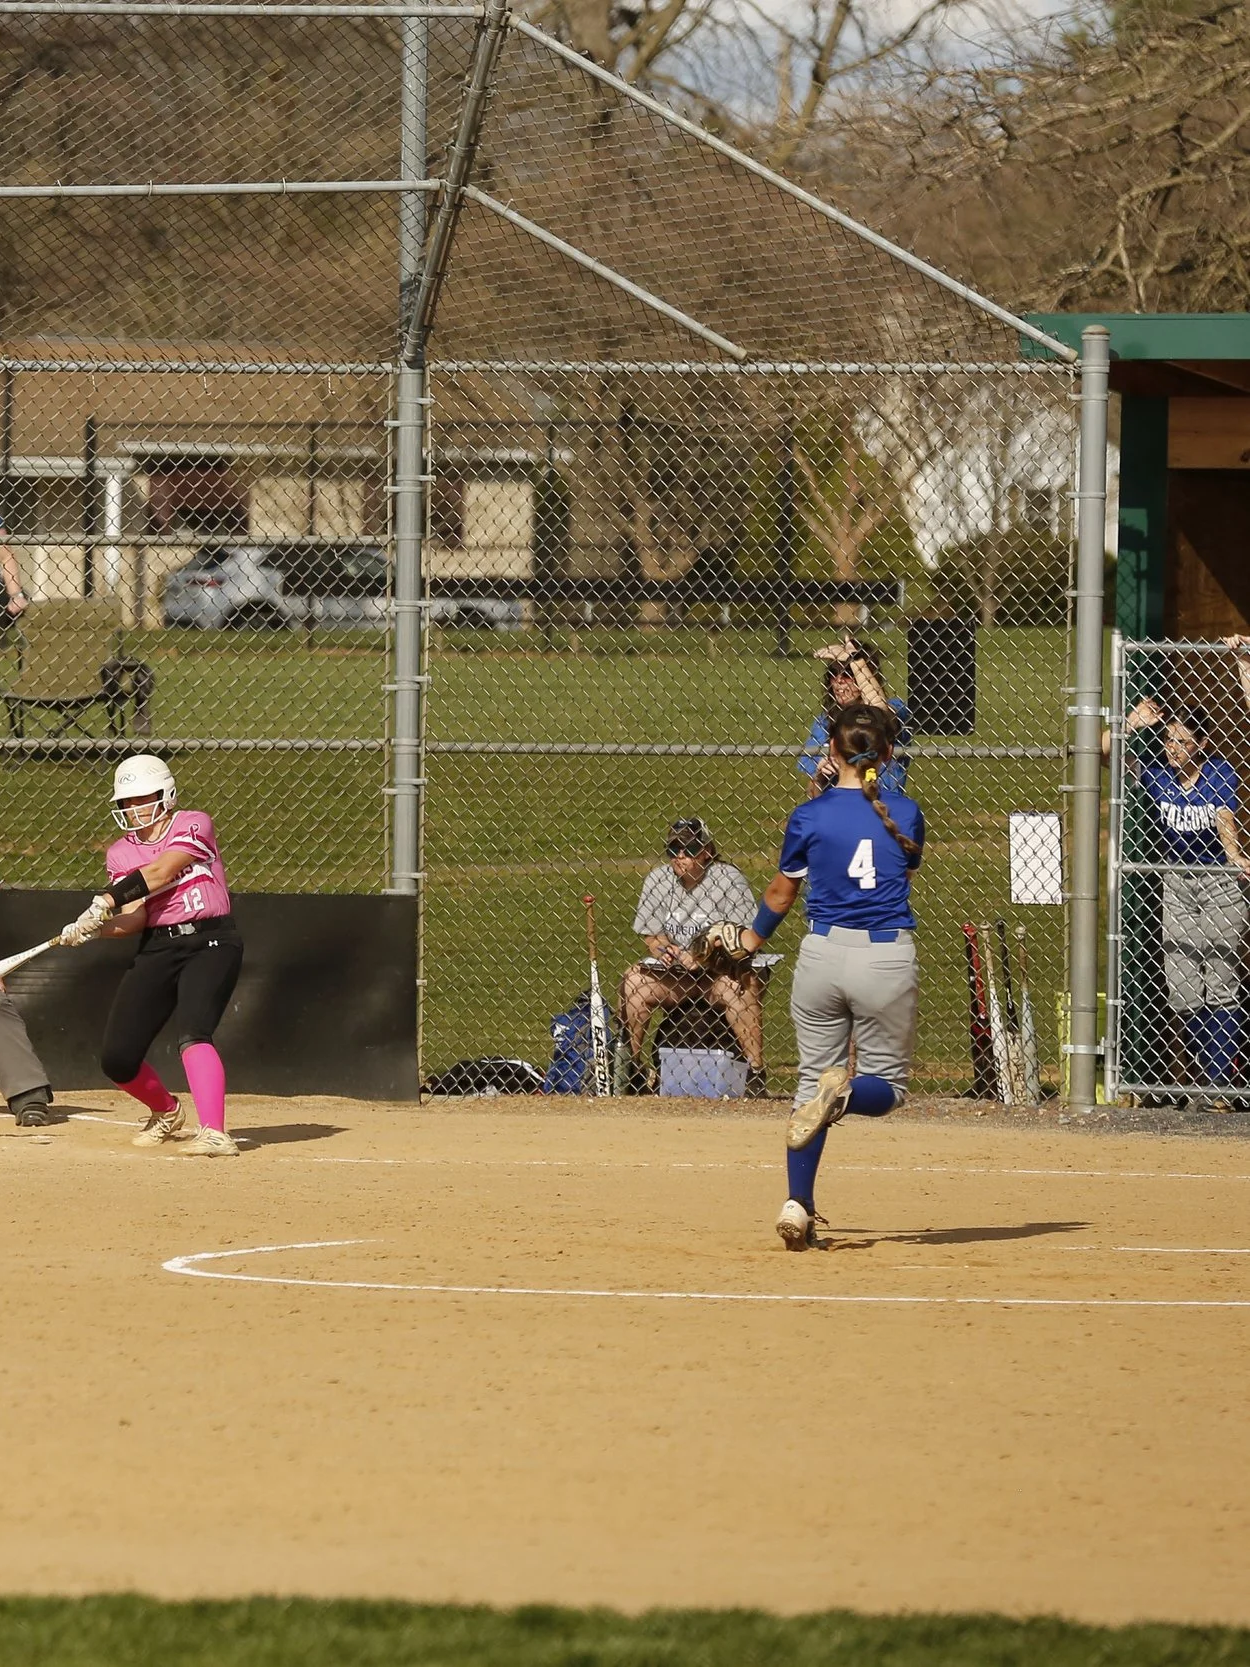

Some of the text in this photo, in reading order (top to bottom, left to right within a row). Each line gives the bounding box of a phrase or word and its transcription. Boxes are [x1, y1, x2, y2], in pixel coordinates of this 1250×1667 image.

[847, 838, 877, 890] 4
[181, 887, 205, 913] 12
[664, 922, 702, 936] FALCON
